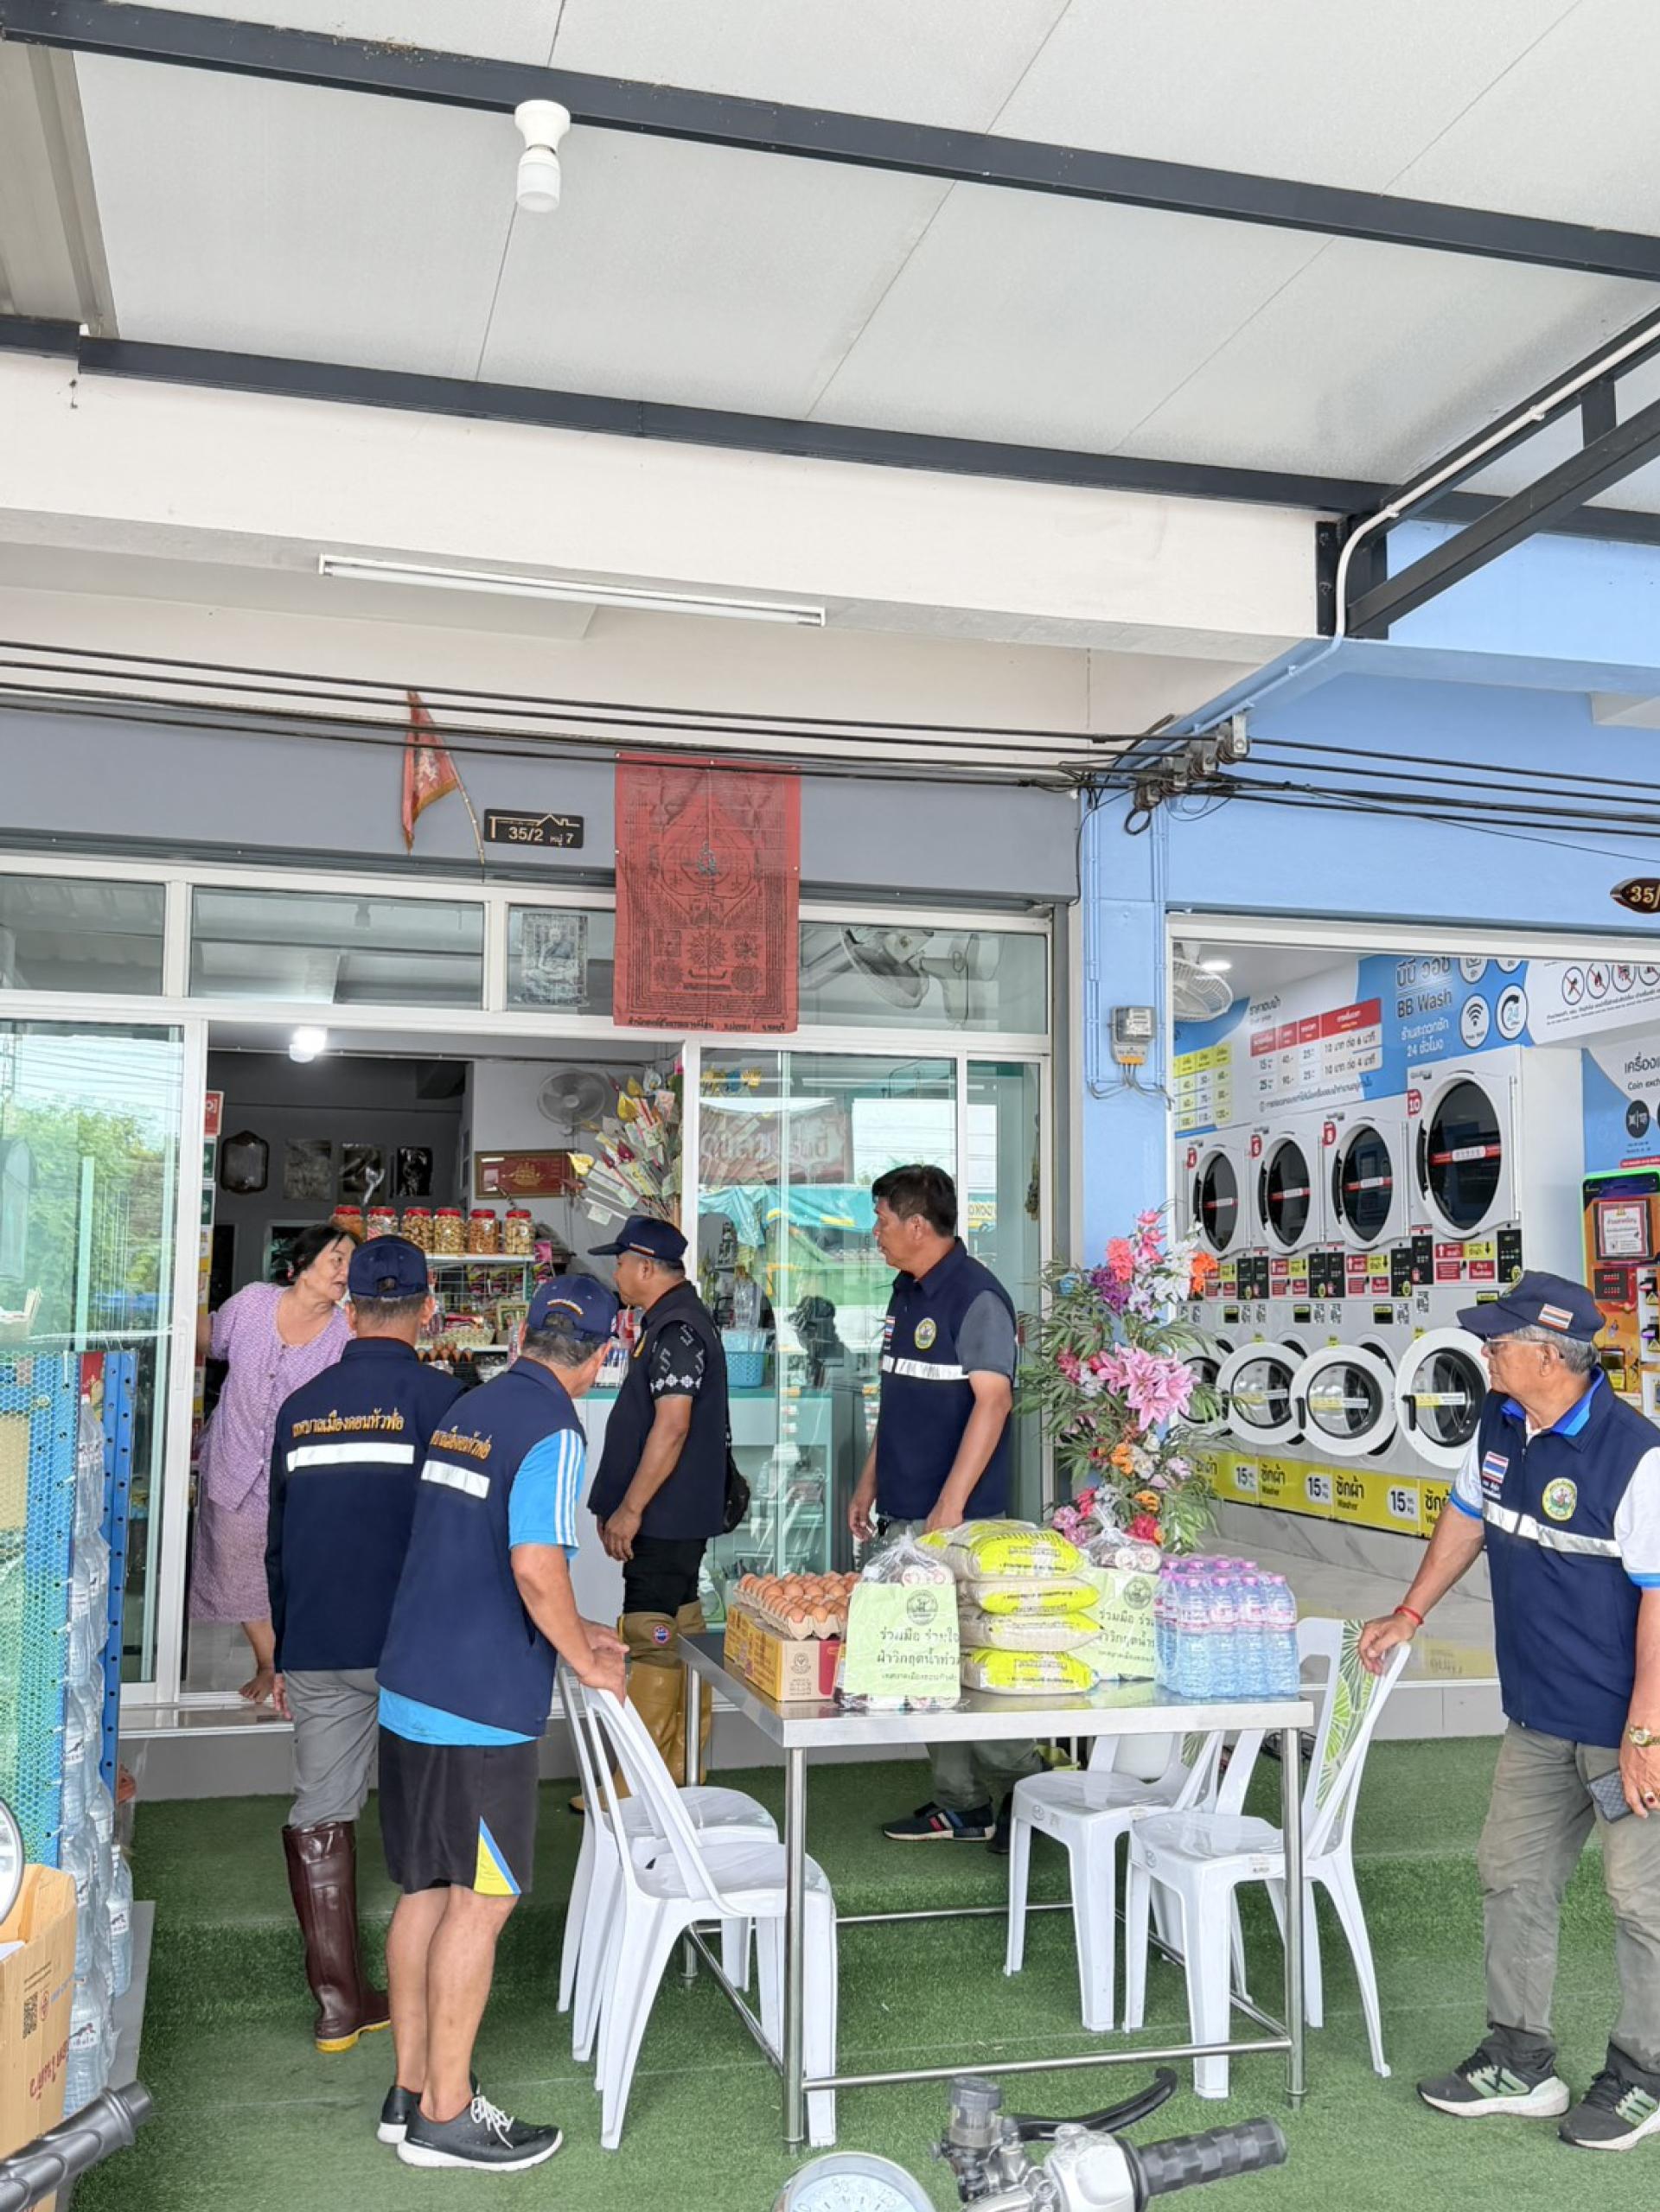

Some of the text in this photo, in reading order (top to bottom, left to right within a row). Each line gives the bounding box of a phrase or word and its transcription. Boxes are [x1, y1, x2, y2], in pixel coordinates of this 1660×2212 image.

[508, 826, 544, 842] 35/2
[565, 832, 574, 844] 7
[1397, 988, 1452, 1018] BB Wash
[1407, 1042, 1418, 1057] 24
[1236, 1466, 1246, 1483] 15
[1308, 1476, 1321, 1497] 15
[1337, 1475, 1364, 1499] ซักผ้า
[1390, 1490, 1405, 1512] 15
